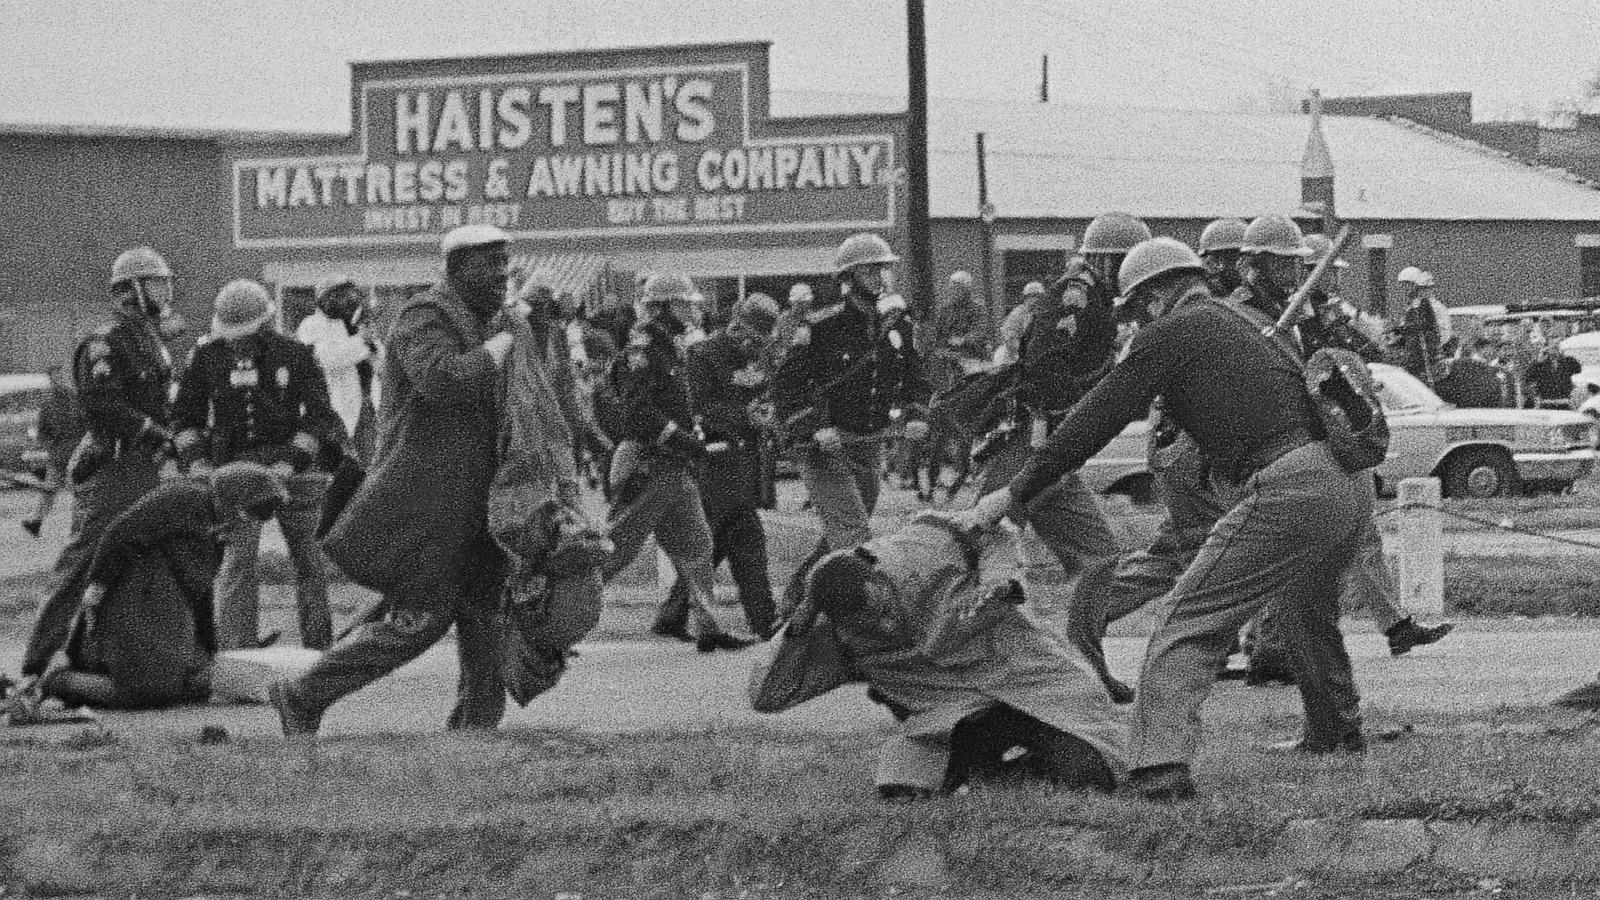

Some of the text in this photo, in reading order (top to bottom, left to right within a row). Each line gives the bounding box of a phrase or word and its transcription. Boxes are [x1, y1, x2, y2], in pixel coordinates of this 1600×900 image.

[396, 80, 715, 153] HAISTEN'S
[257, 161, 468, 207] MATTRESS
[485, 159, 509, 199] &
[528, 150, 679, 196] AWNING
[698, 145, 880, 190] COMPANY
[652, 197, 686, 221] THE
